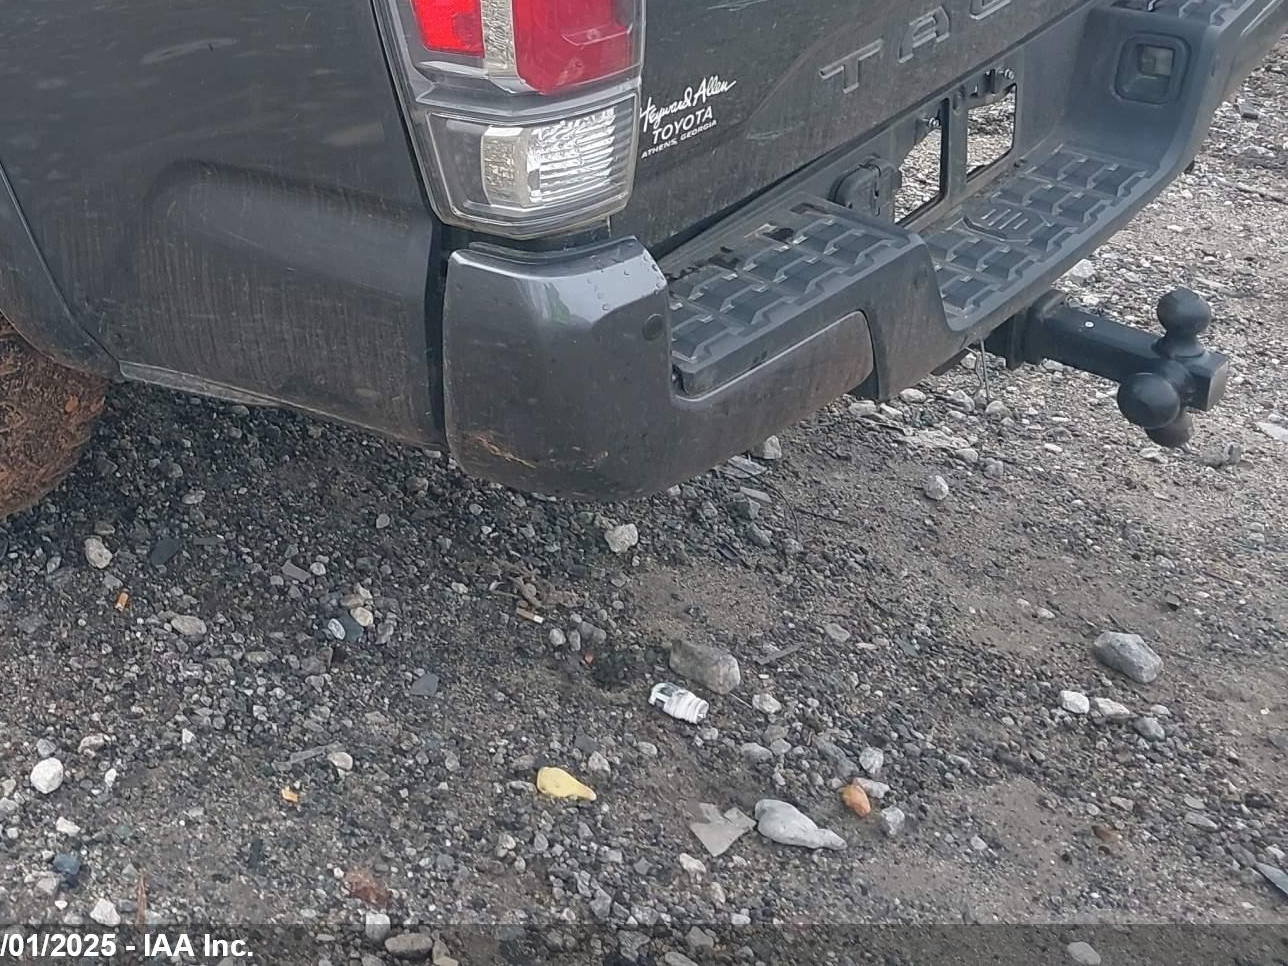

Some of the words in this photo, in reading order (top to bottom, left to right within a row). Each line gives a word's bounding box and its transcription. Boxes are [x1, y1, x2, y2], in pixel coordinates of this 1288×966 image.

[692, 75, 737, 107] Allen
[652, 107, 713, 145] TOYOTA
[680, 120, 718, 141] GEORGIA
